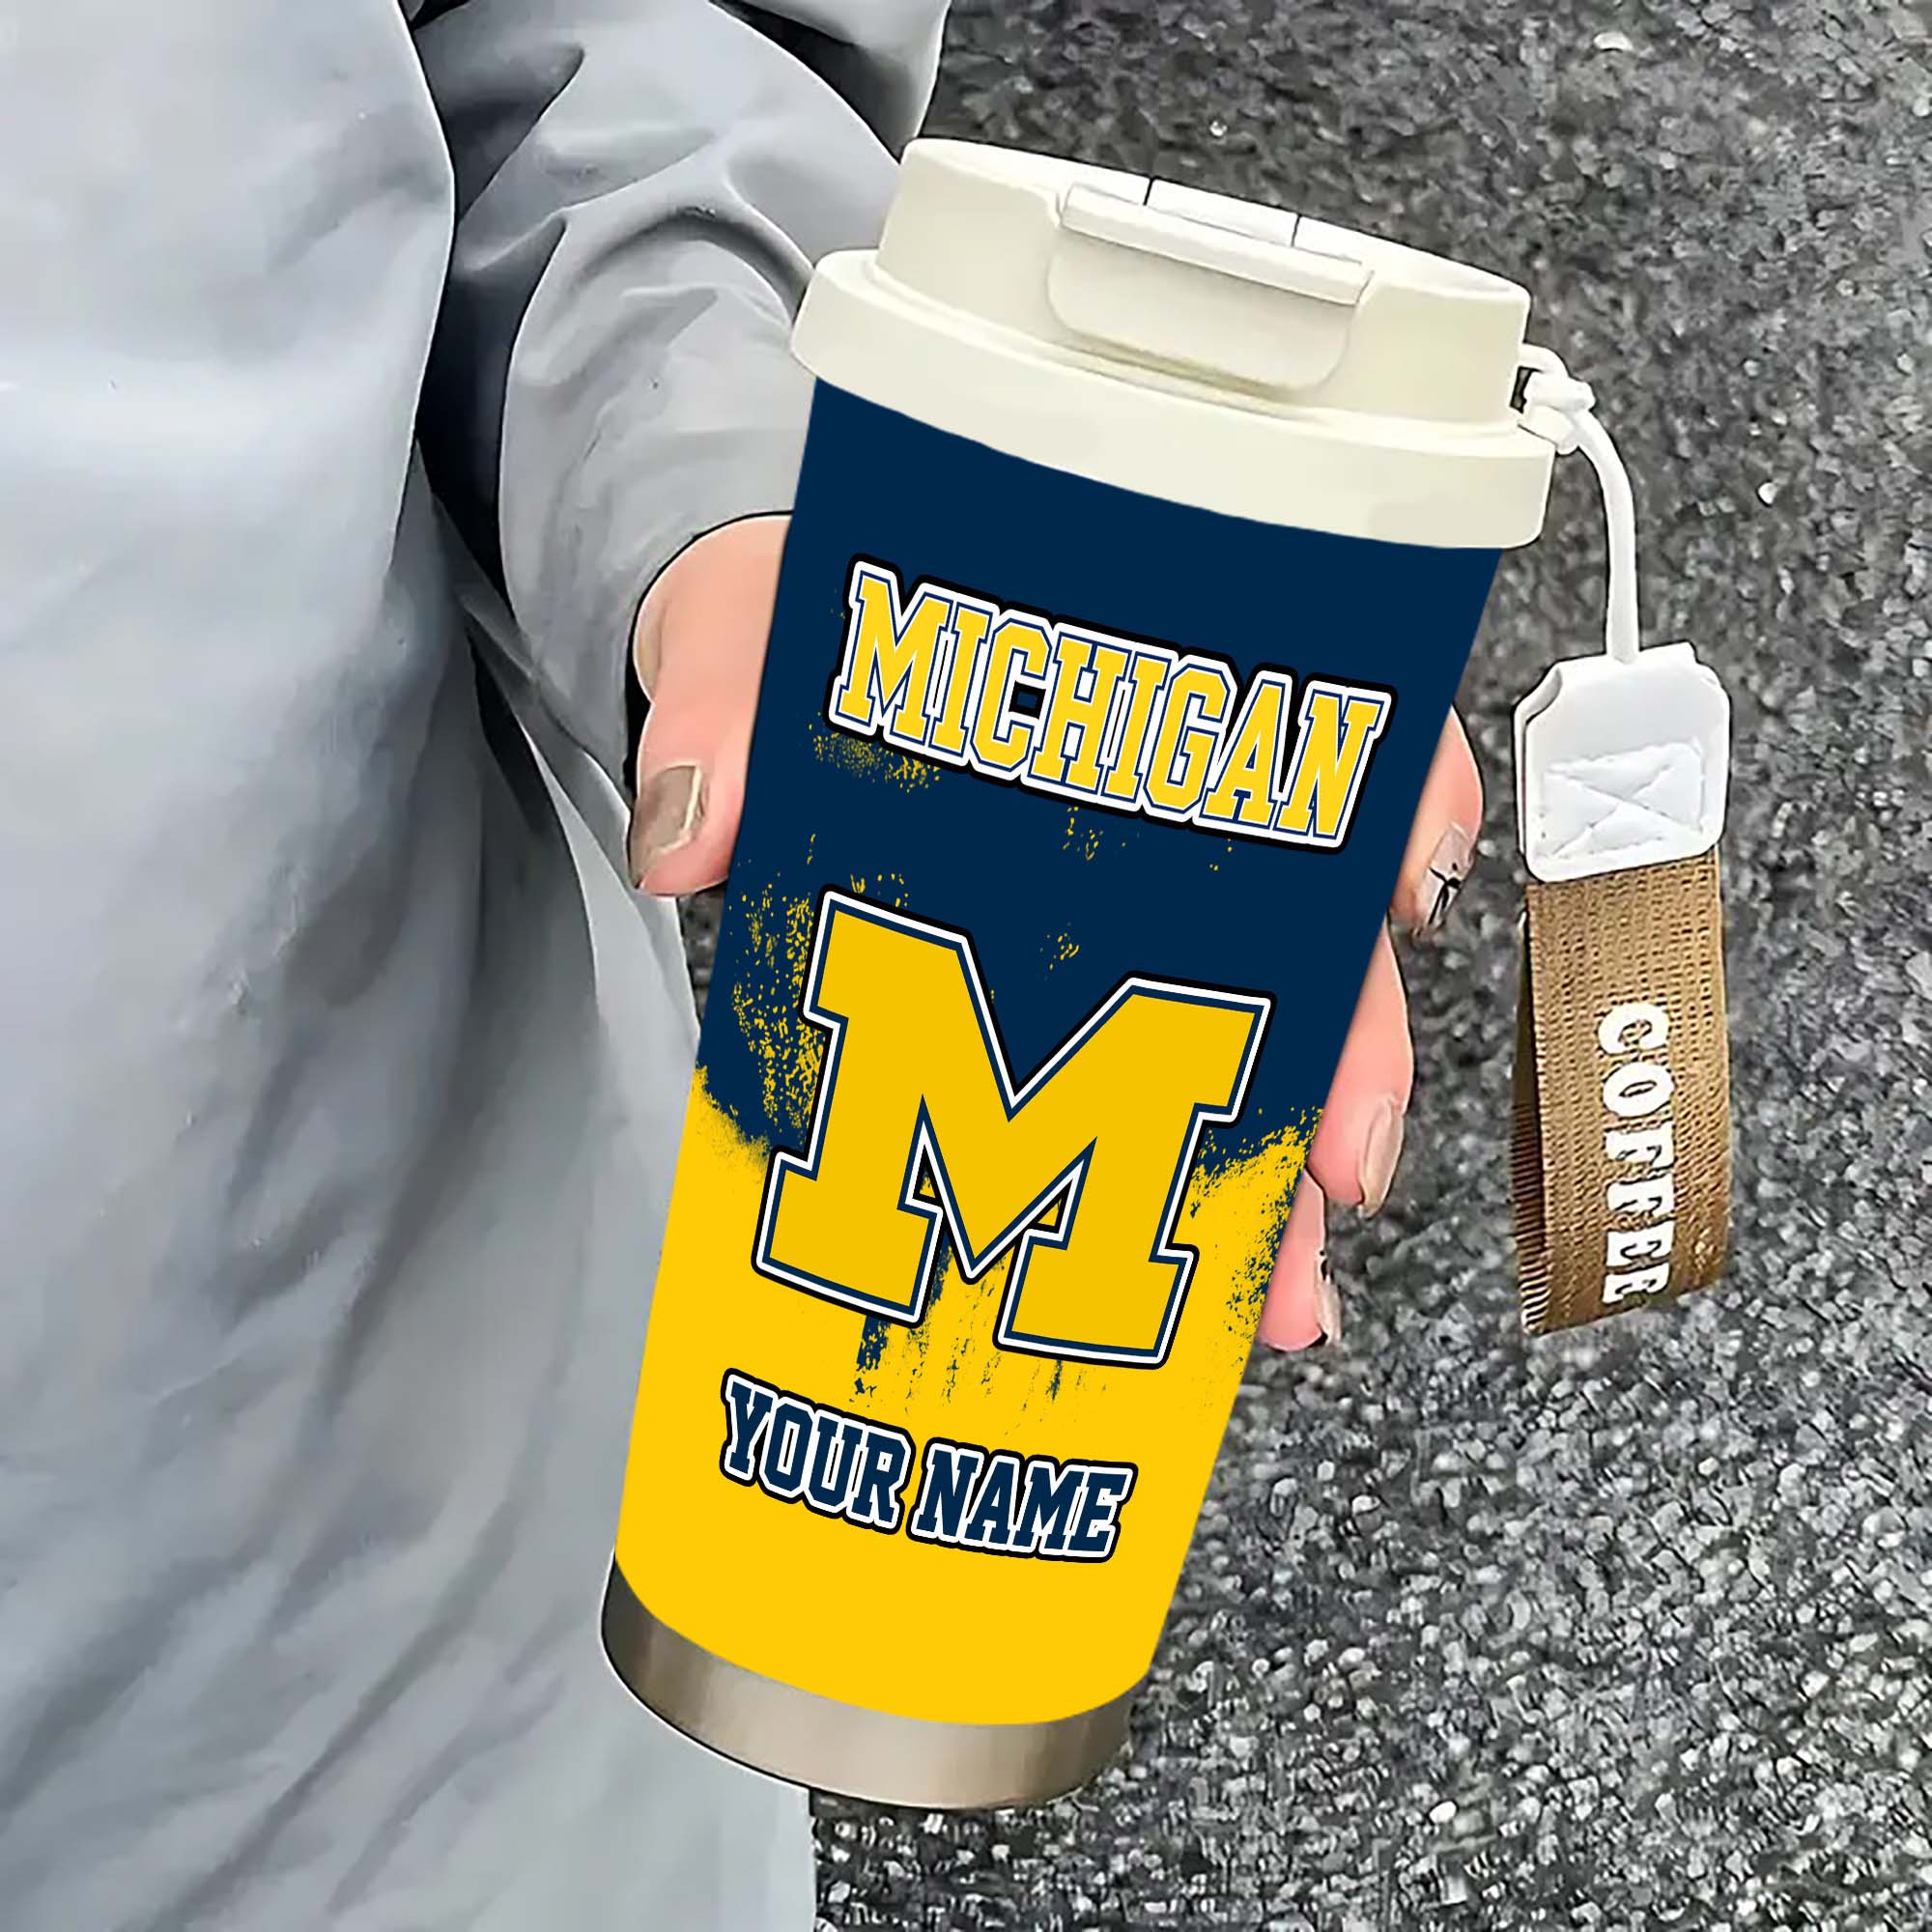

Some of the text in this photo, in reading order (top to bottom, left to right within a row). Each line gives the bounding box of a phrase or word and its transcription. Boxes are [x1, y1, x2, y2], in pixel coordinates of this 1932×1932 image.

[828, 561, 1392, 848] MICHIGAN
[756, 891, 1271, 1364] M
[1599, 1002, 1675, 1304] COFFEE
[721, 1375, 1134, 1557] YOUR NAME
